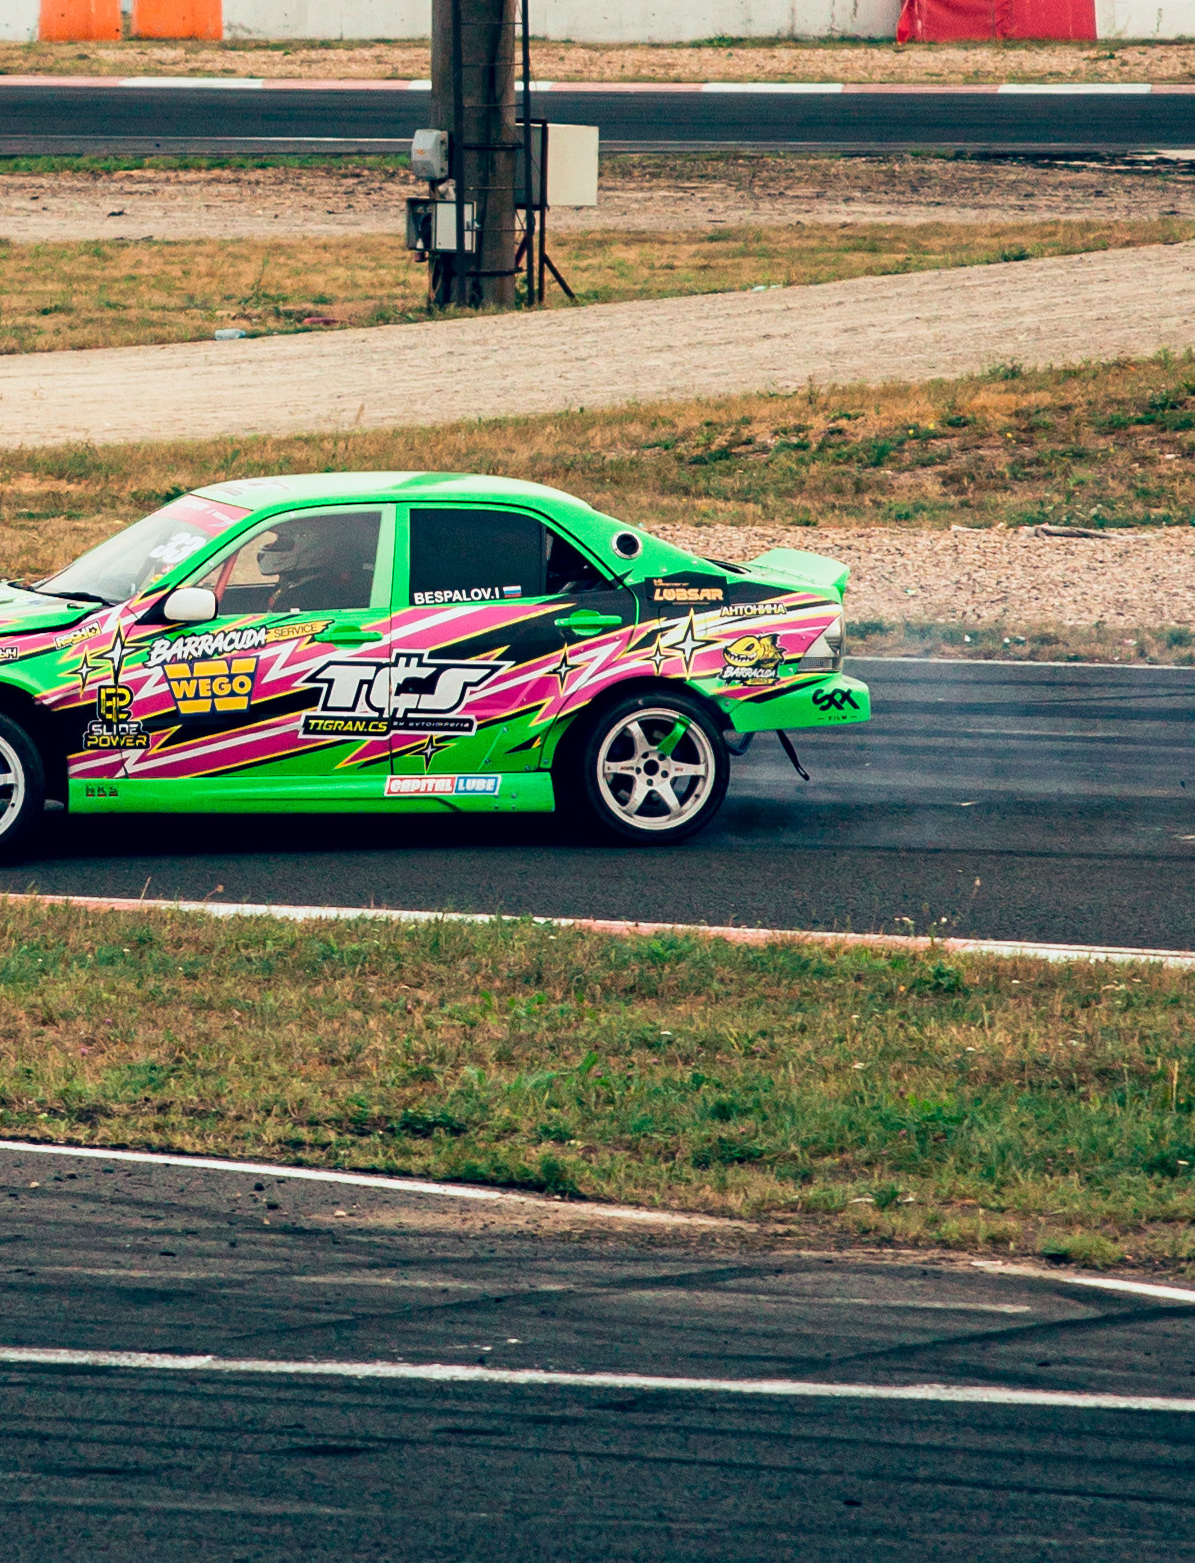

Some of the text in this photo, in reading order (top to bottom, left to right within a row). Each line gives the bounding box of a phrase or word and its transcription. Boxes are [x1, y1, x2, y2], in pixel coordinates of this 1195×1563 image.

[413, 586, 500, 605] BESPALOV.I
[721, 603, 787, 617] АНТОНИНА
[145, 622, 318, 667] BARRACUDA SERVICE
[170, 674, 253, 699] WEGO
[91, 723, 139, 736] SLIDE
[307, 718, 388, 733] TIGRAN.CS
[87, 735, 148, 747] POWER
[457, 778, 496, 792] LUBE
